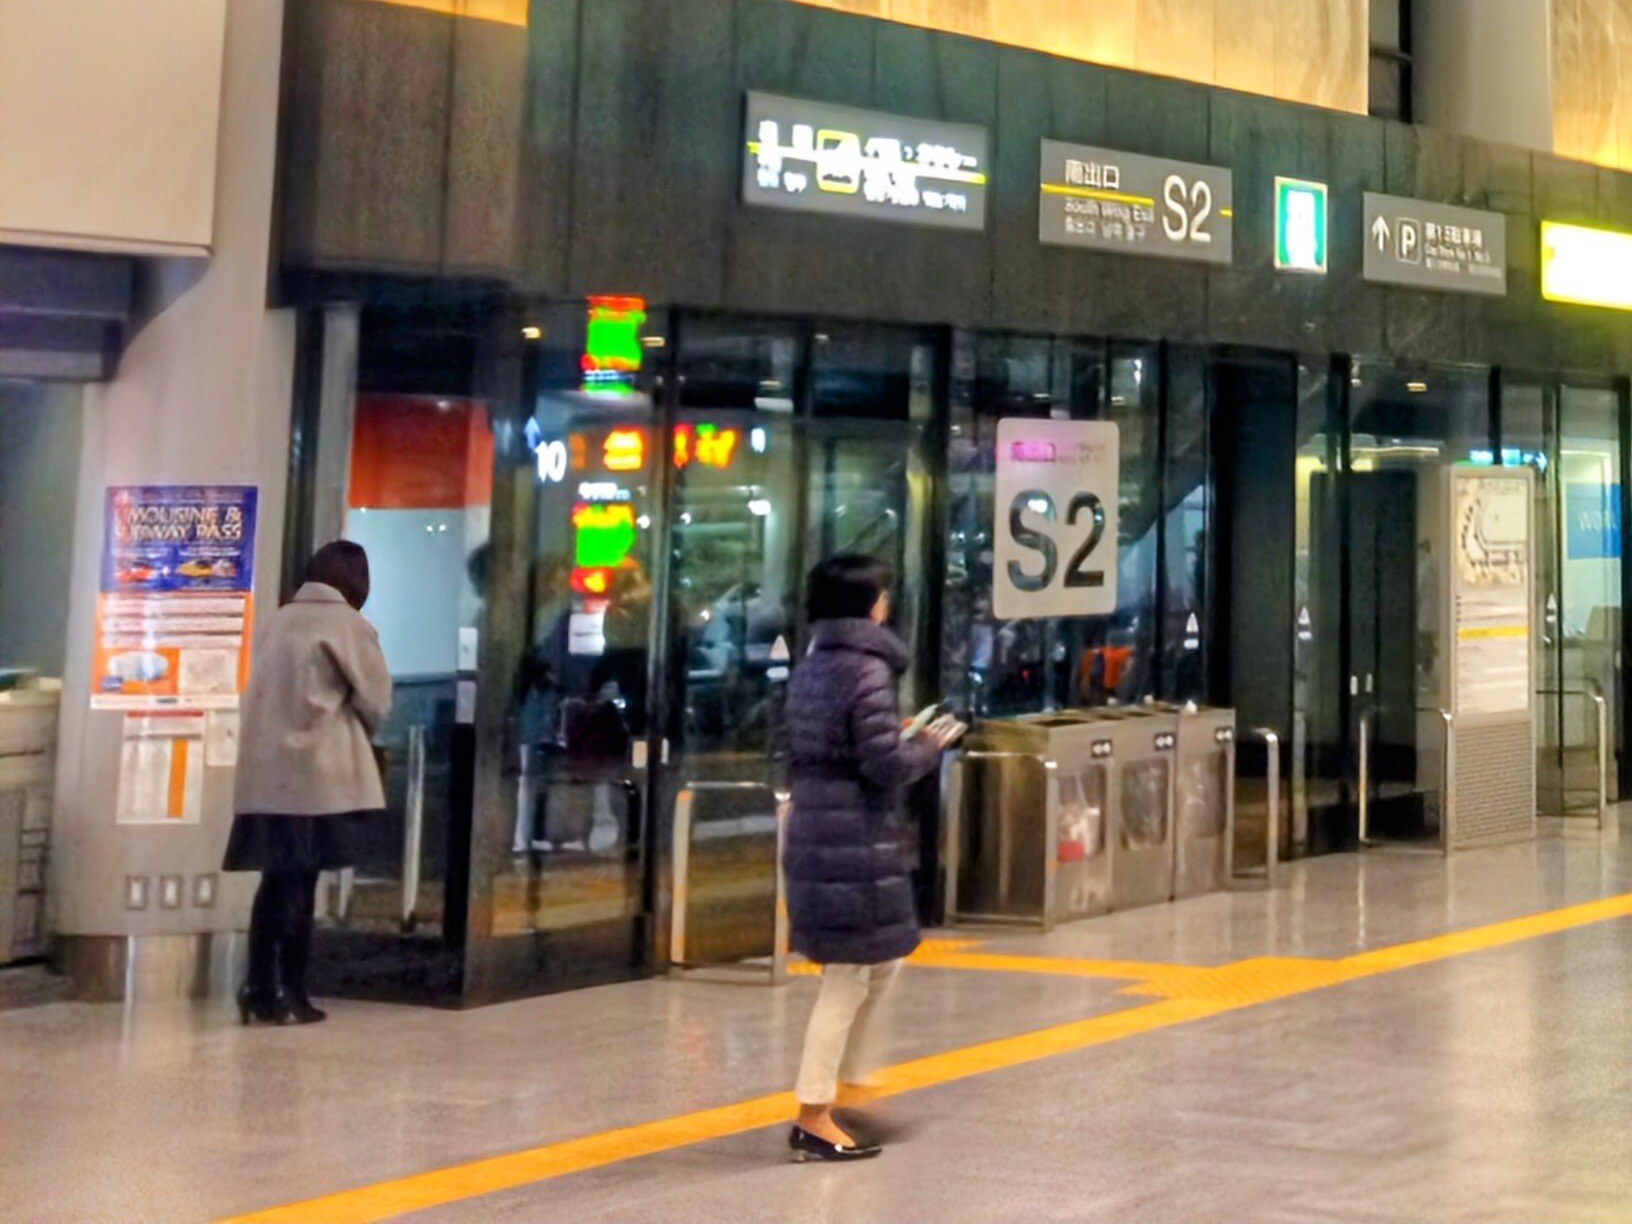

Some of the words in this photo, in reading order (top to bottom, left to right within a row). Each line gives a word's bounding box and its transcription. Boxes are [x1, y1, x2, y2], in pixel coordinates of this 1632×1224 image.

[1162, 174, 1212, 243] S2
[1401, 224, 1417, 256] P
[196, 524, 242, 540] PASS
[1006, 489, 1105, 593] S2
